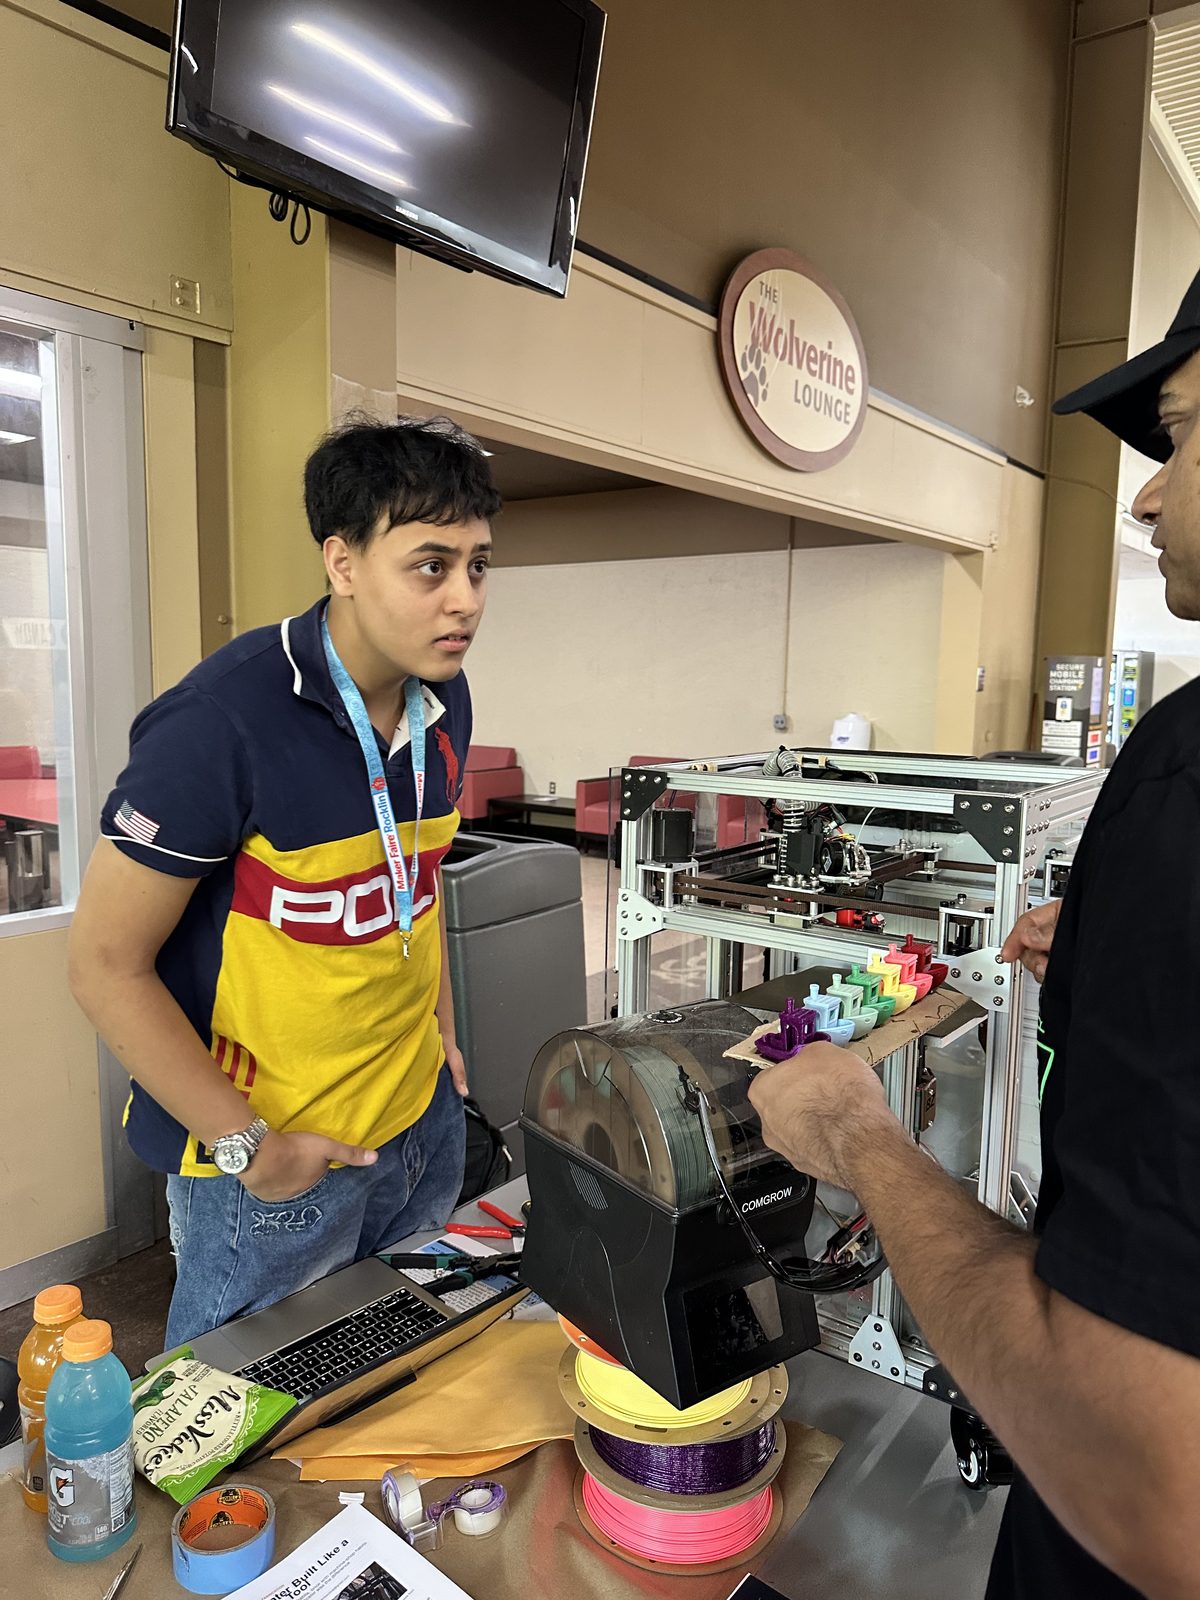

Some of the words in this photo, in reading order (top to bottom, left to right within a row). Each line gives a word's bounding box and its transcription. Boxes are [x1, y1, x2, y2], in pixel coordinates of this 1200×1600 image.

[759, 280, 779, 304] THE
[748, 301, 857, 396] Wolverine
[794, 379, 851, 426] LOUNGE
[1049, 670, 1085, 679] MOBILE
[380, 794, 392, 833] Rocklin
[389, 834, 398, 858] Faire
[394, 859, 406, 890] Maker
[741, 1186, 793, 1213] COMGROW
[142, 1384, 198, 1443] JALAPEÑO
[194, 1385, 242, 1428] Miss
[143, 1424, 216, 1477] Vickie's
[50, 1466, 76, 1507] G
[290, 1563, 320, 1589] Built
[316, 1546, 341, 1566] Like
[340, 1538, 350, 1547] a
